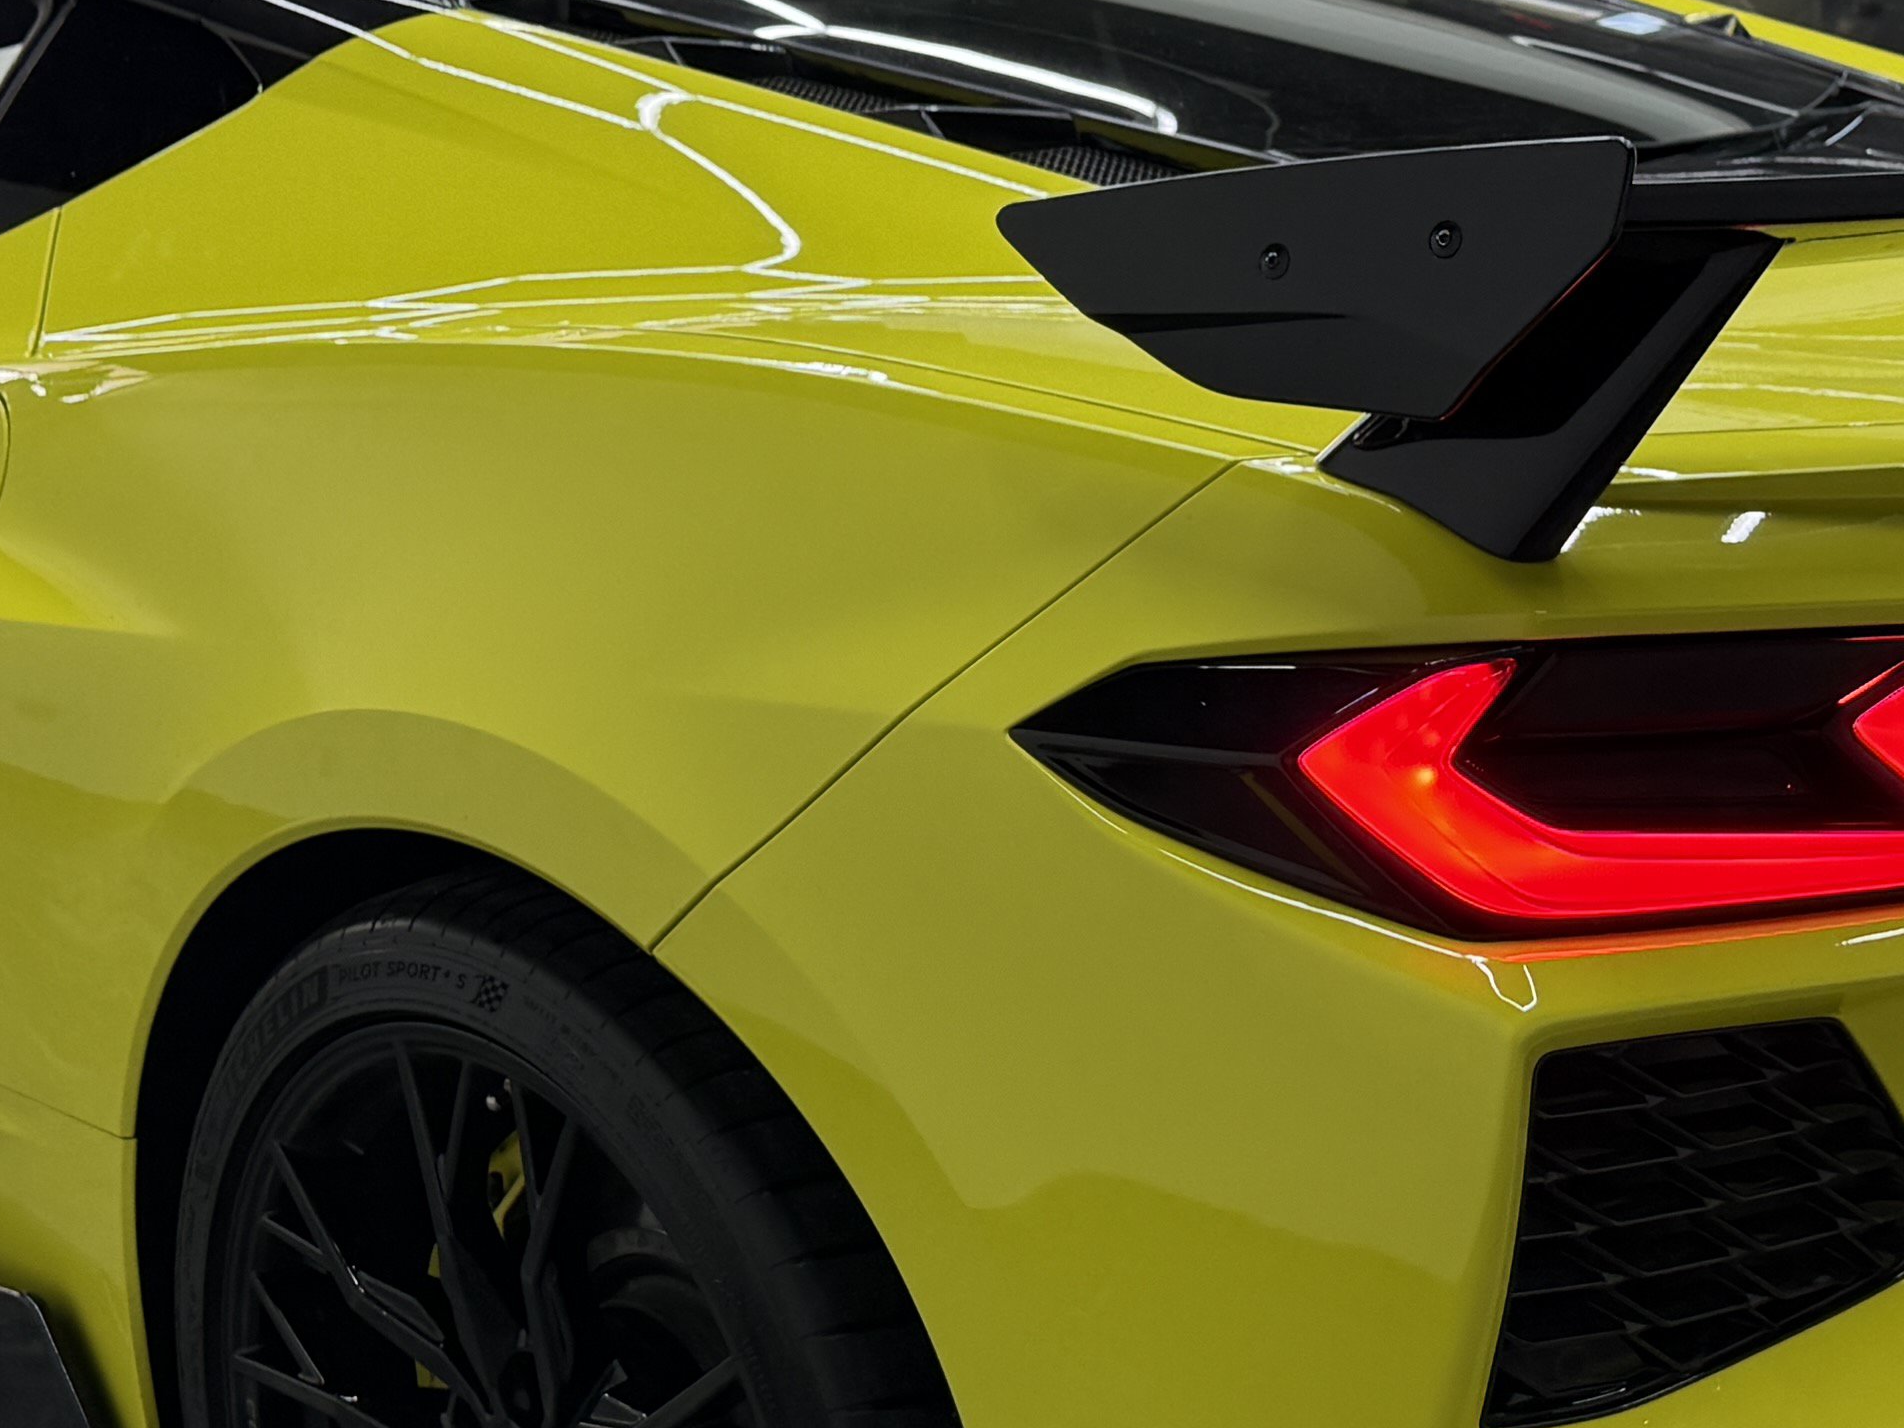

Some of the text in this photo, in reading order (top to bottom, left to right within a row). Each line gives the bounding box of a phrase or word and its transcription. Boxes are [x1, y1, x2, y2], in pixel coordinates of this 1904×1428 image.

[338, 961, 381, 986] PILOT
[386, 960, 441, 982] SPORT
[455, 972, 467, 990] S
